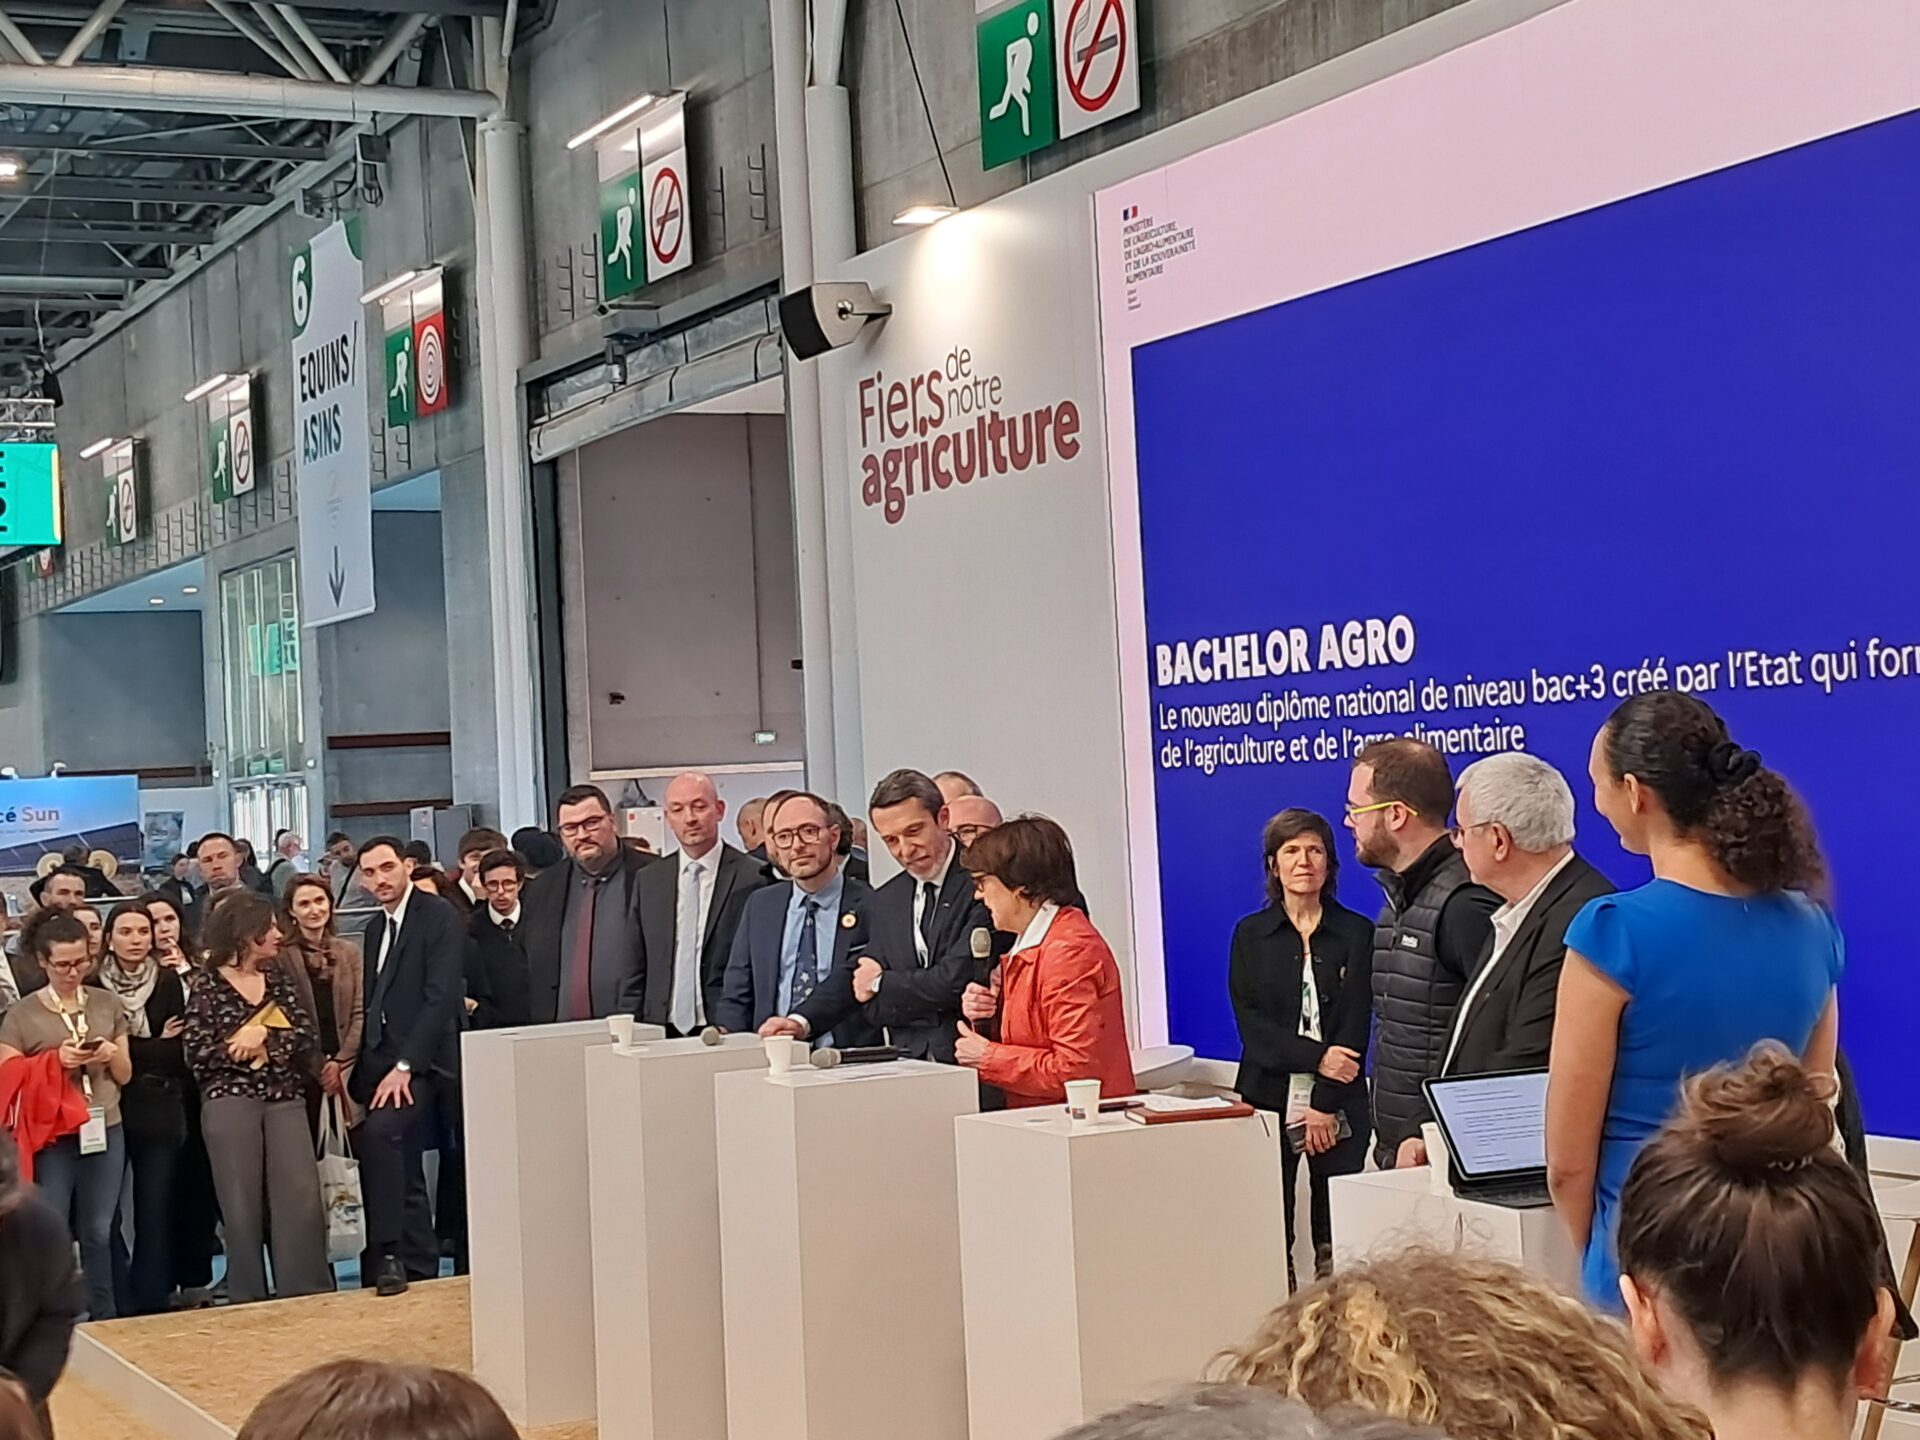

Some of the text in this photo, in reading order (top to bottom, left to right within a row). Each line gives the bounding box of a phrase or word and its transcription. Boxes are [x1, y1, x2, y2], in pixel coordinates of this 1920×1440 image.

[1123, 237, 1132, 249] DE
[1124, 249, 1132, 261] DE
[1125, 262, 1132, 273] ET
[1133, 259, 1141, 270] DE
[1142, 256, 1149, 267] LA
[292, 254, 308, 328] 6
[859, 345, 971, 449] Fiers de
[948, 375, 1002, 419] notre
[303, 403, 342, 466] ASINS
[861, 400, 1081, 525] agriculture
[1156, 614, 1415, 686] BACHELOR AGRO
[1159, 703, 1177, 730] Le
[1181, 702, 1251, 729] nouveau
[1256, 690, 1331, 731] diplôme
[1336, 679, 1416, 718] national
[1421, 678, 1448, 712] de
[1454, 674, 1525, 708] niveau
[1531, 664, 1606, 703] bac+3
[1612, 657, 1669, 698] créé
[1676, 662, 1720, 693] par
[1810, 640, 1858, 694] qui
[1865, 637, 1920, 678] for
[1161, 740, 1181, 768] de
[1185, 735, 1285, 775] l'agriculture
[1290, 736, 1309, 761] et
[1313, 729, 1338, 760] de
[21, 806, 60, 823] Sun
